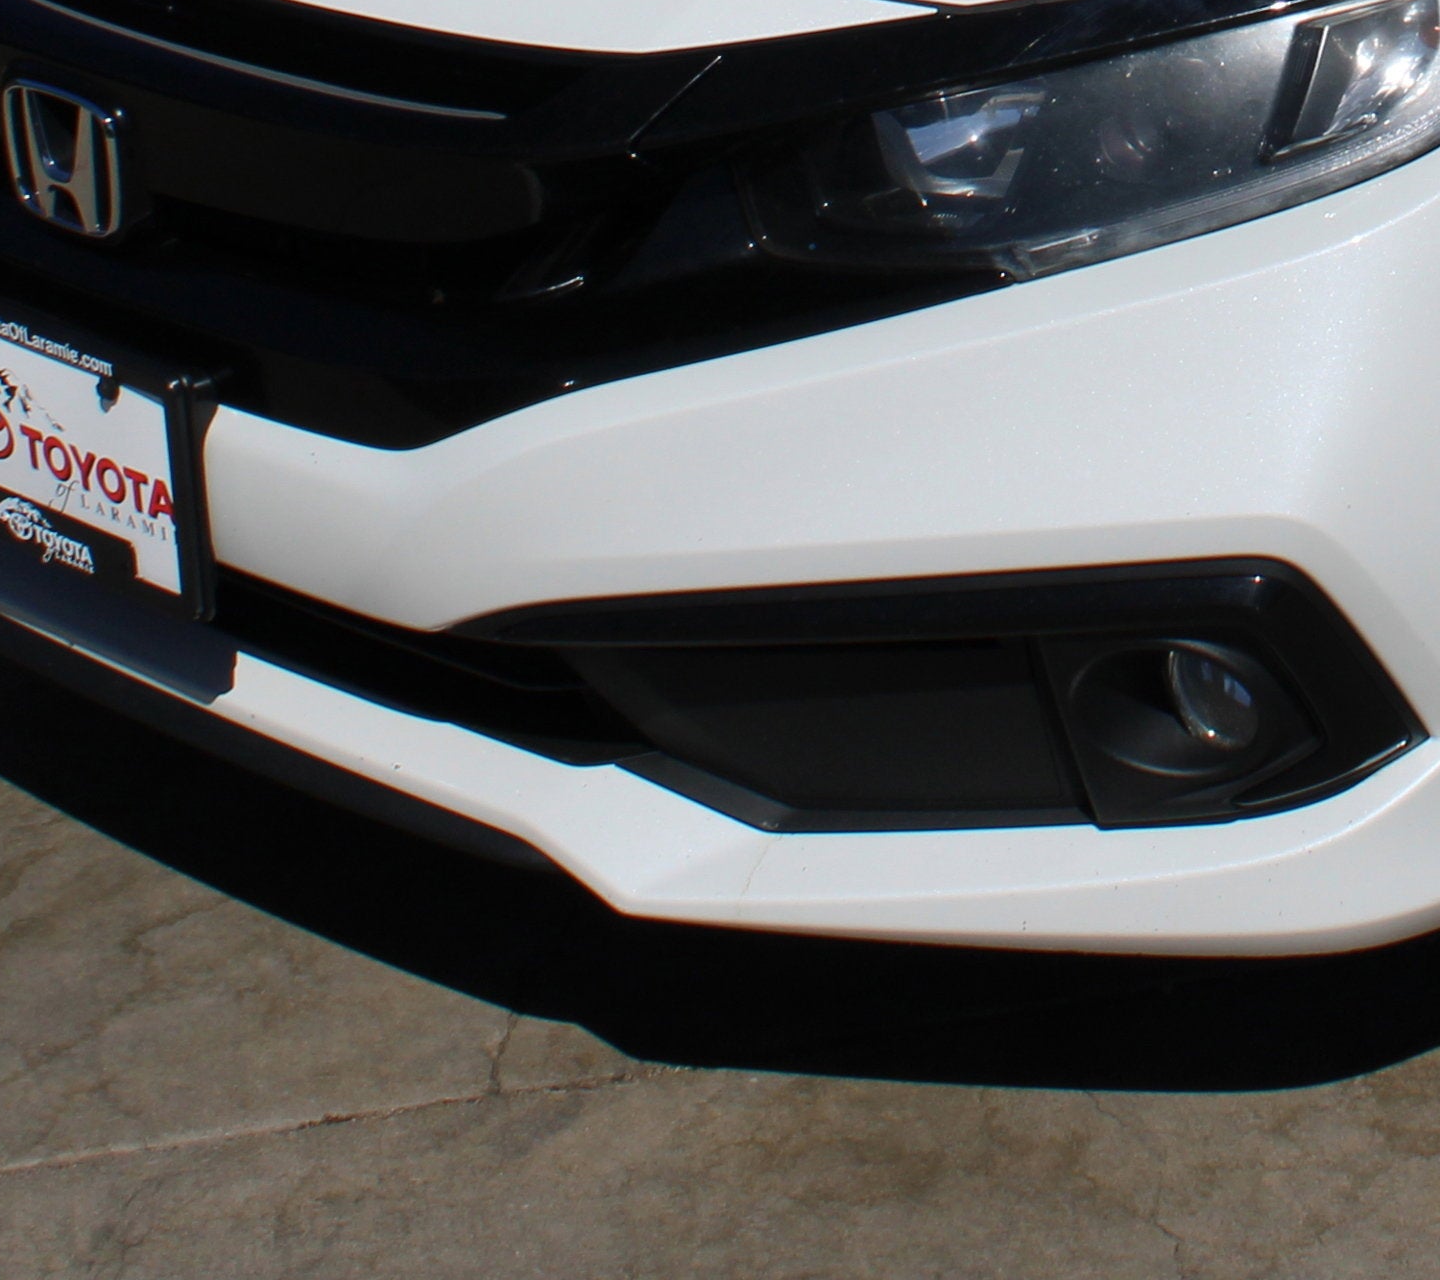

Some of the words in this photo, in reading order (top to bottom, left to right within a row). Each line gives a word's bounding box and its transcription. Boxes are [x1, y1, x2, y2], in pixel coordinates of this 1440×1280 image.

[20, 423, 176, 520] TOYOTA
[80, 492, 176, 544] LARAMI
[32, 523, 94, 566] TOYOTA
